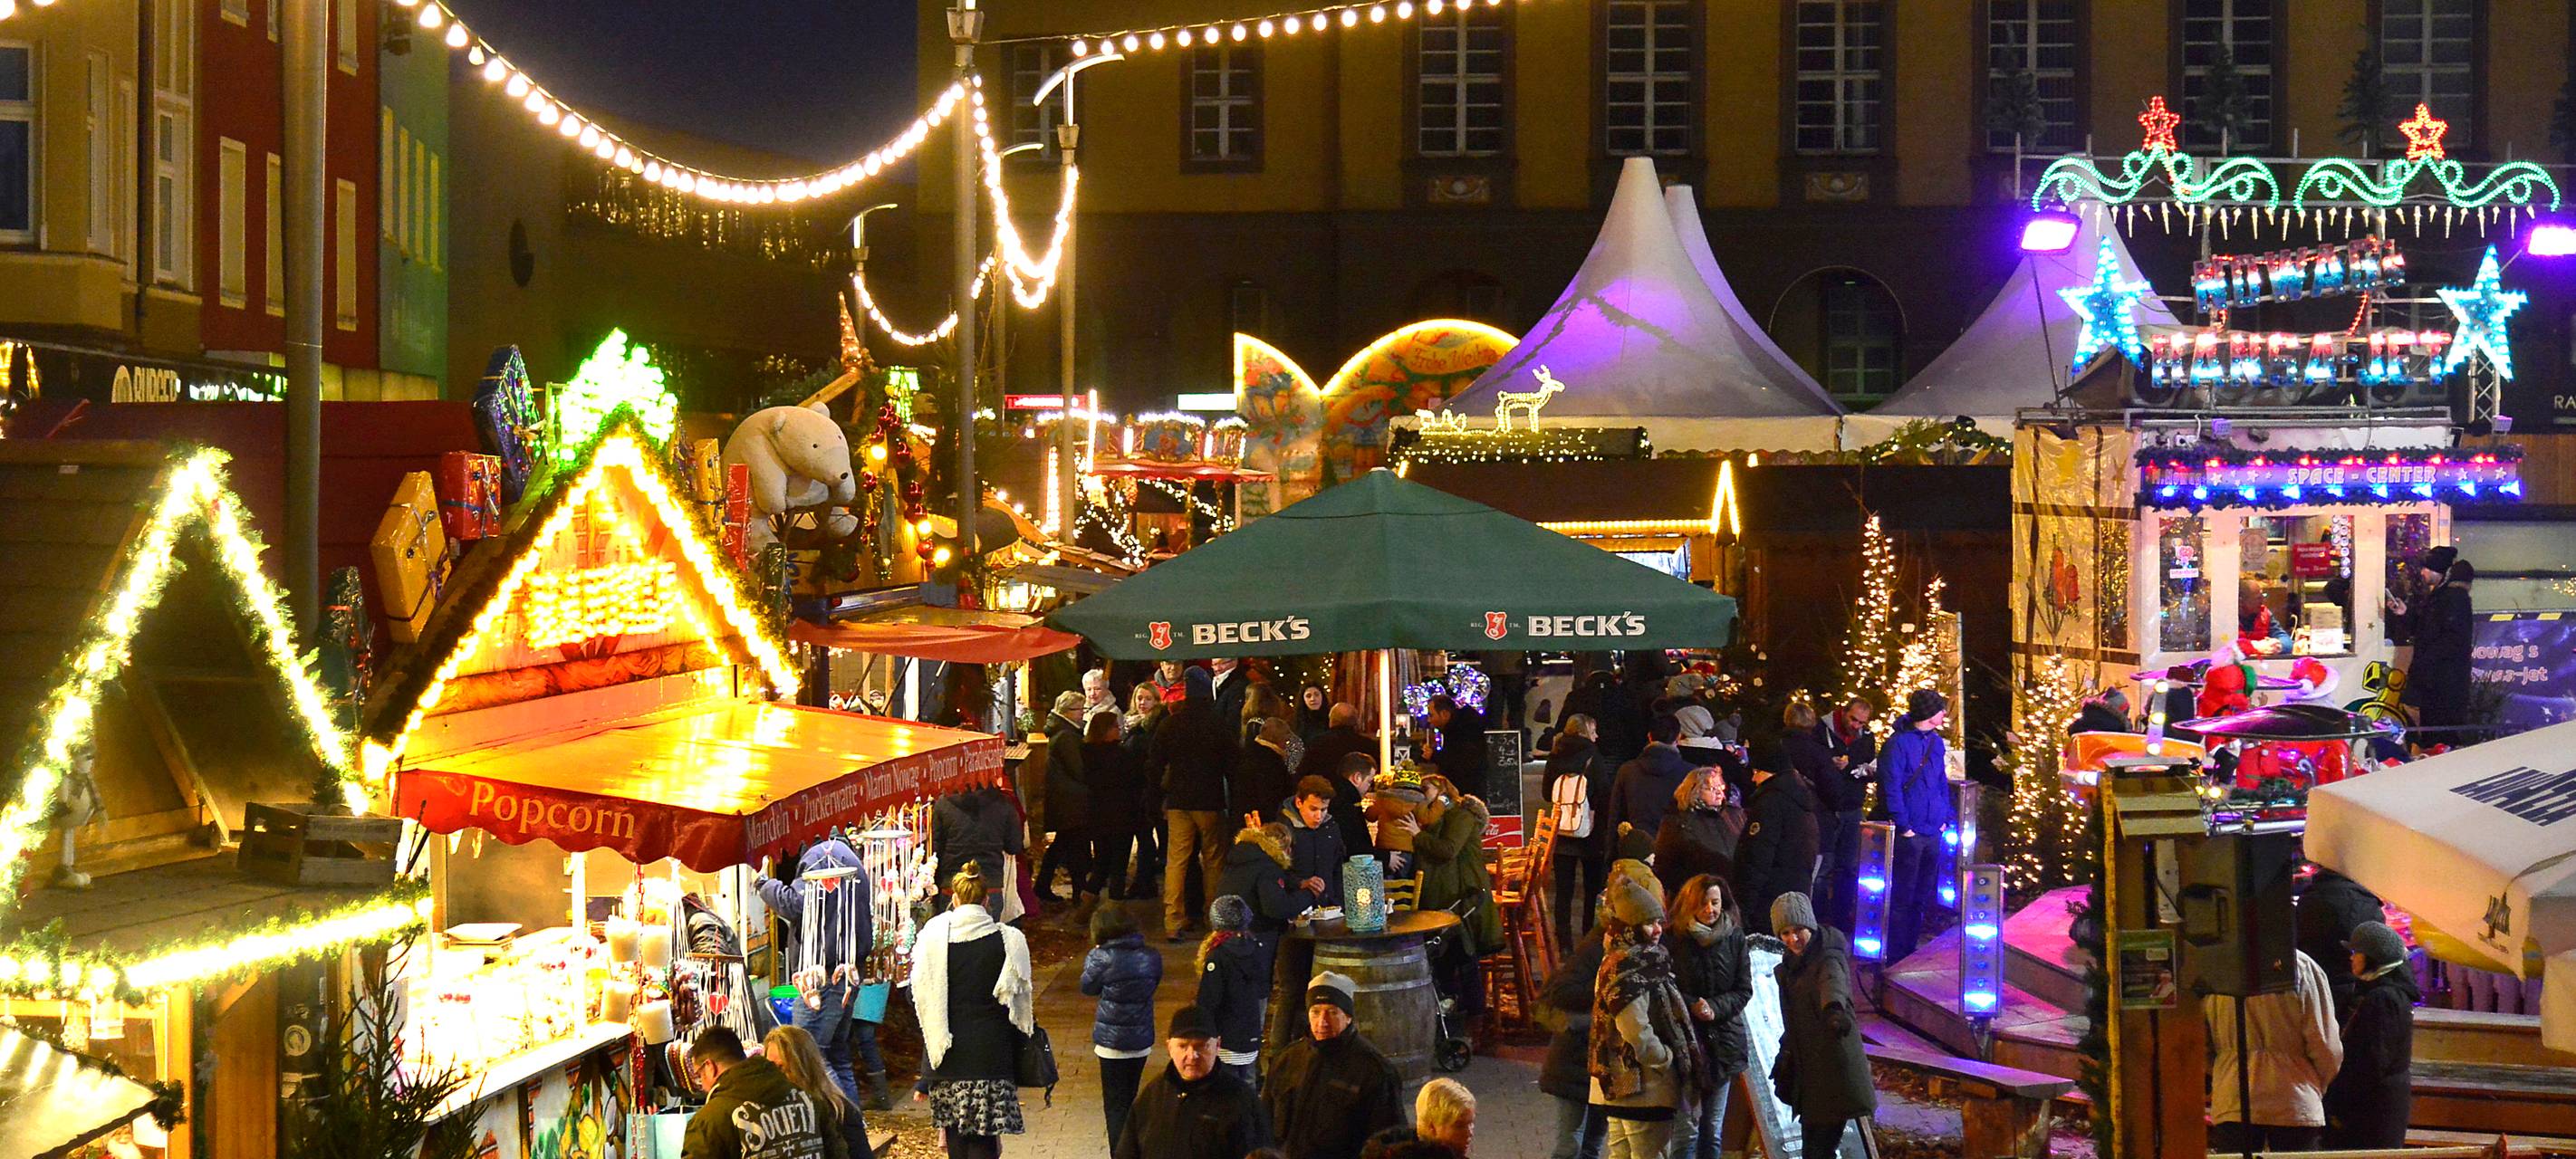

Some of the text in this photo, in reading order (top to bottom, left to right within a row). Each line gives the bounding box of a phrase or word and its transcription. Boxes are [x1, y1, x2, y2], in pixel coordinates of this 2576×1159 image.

[2151, 332, 2451, 388] HANSA-JET
[2287, 467, 2345, 485] SPACE
[2366, 465, 2437, 484] CENTER
[1192, 616, 1310, 646] BECK'S
[1528, 611, 1645, 637] BECK'S
[468, 780, 635, 839] Popcorn
[802, 787, 858, 827] Zuckerwatte
[863, 764, 892, 802] Martin
[893, 761, 919, 795] Nowag
[928, 753, 957, 790] Popcorn
[732, 1090, 816, 1152] SOCIETY
